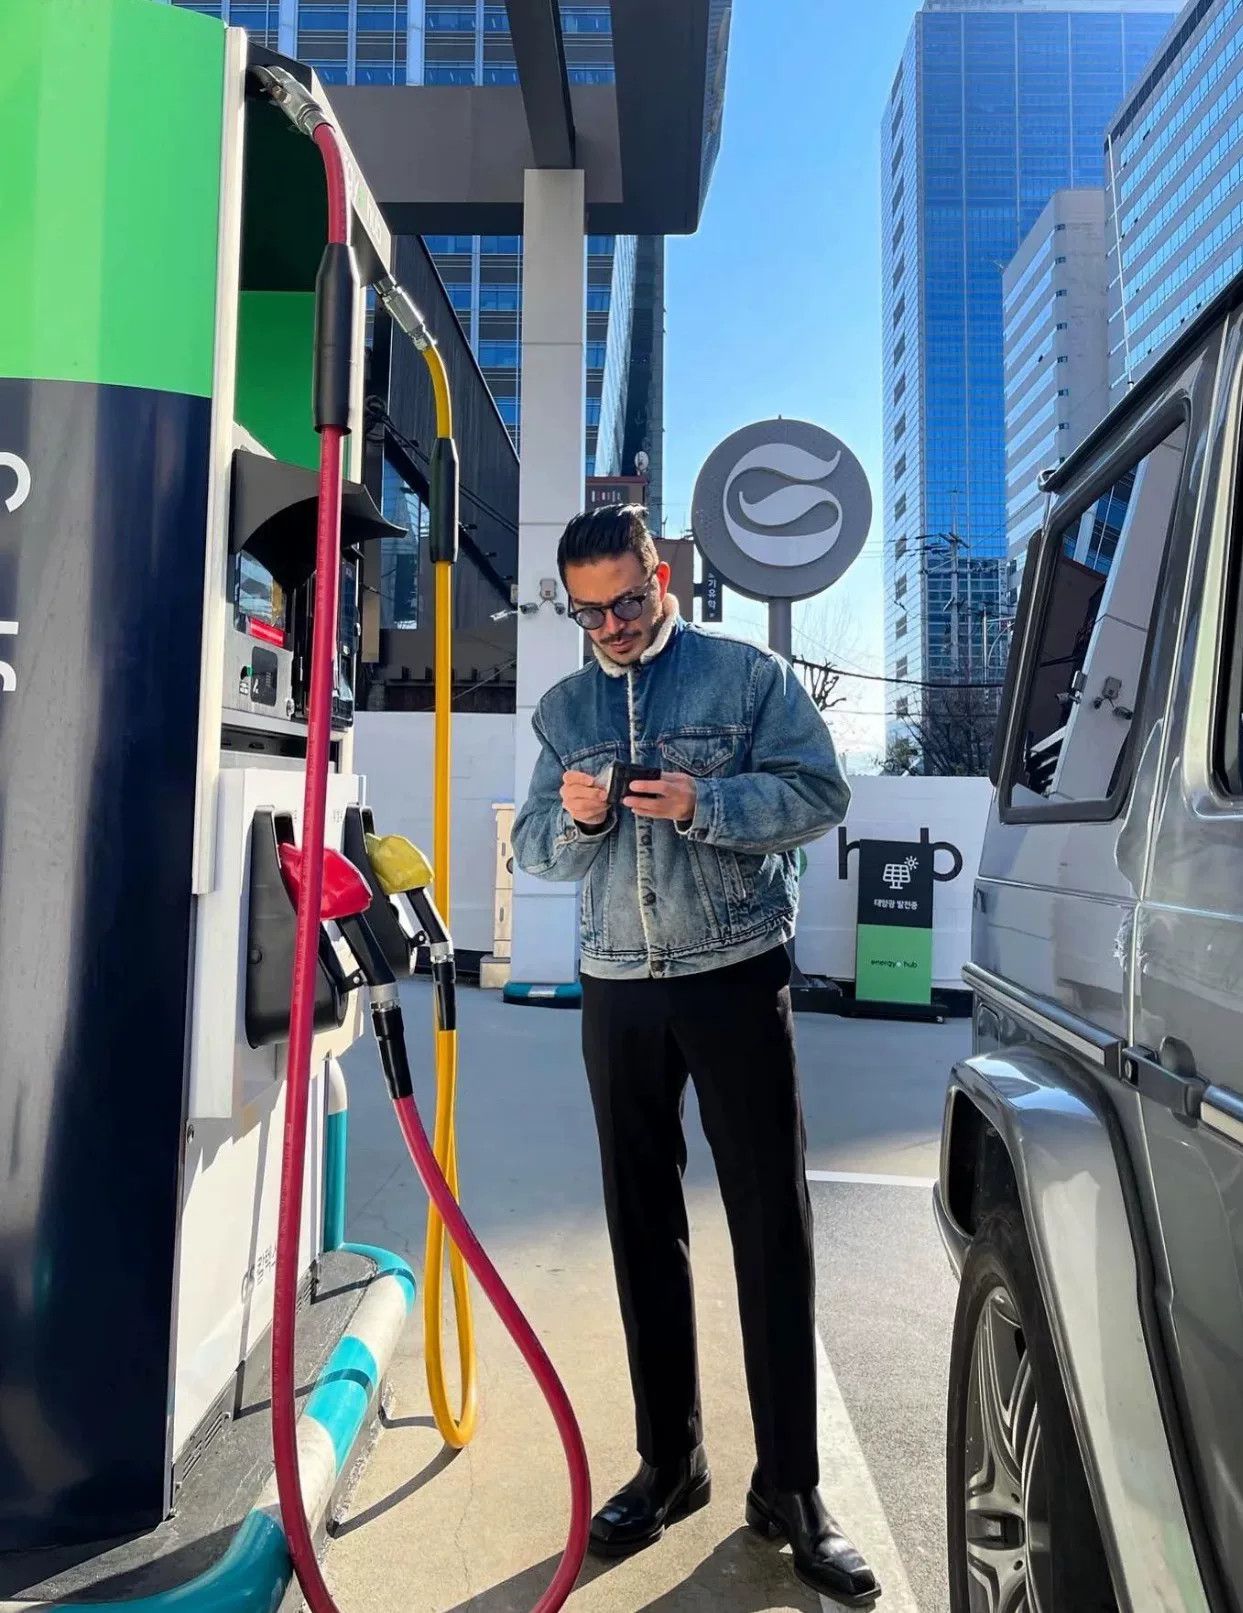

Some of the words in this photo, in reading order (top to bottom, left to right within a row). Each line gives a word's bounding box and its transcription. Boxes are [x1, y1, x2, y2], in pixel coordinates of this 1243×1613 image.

[838, 826, 963, 882] hb
[873, 898, 895, 909] 태양광
[896, 900, 918, 910] 발전중
[871, 960, 896, 968] energy
[903, 960, 918, 968] hub
